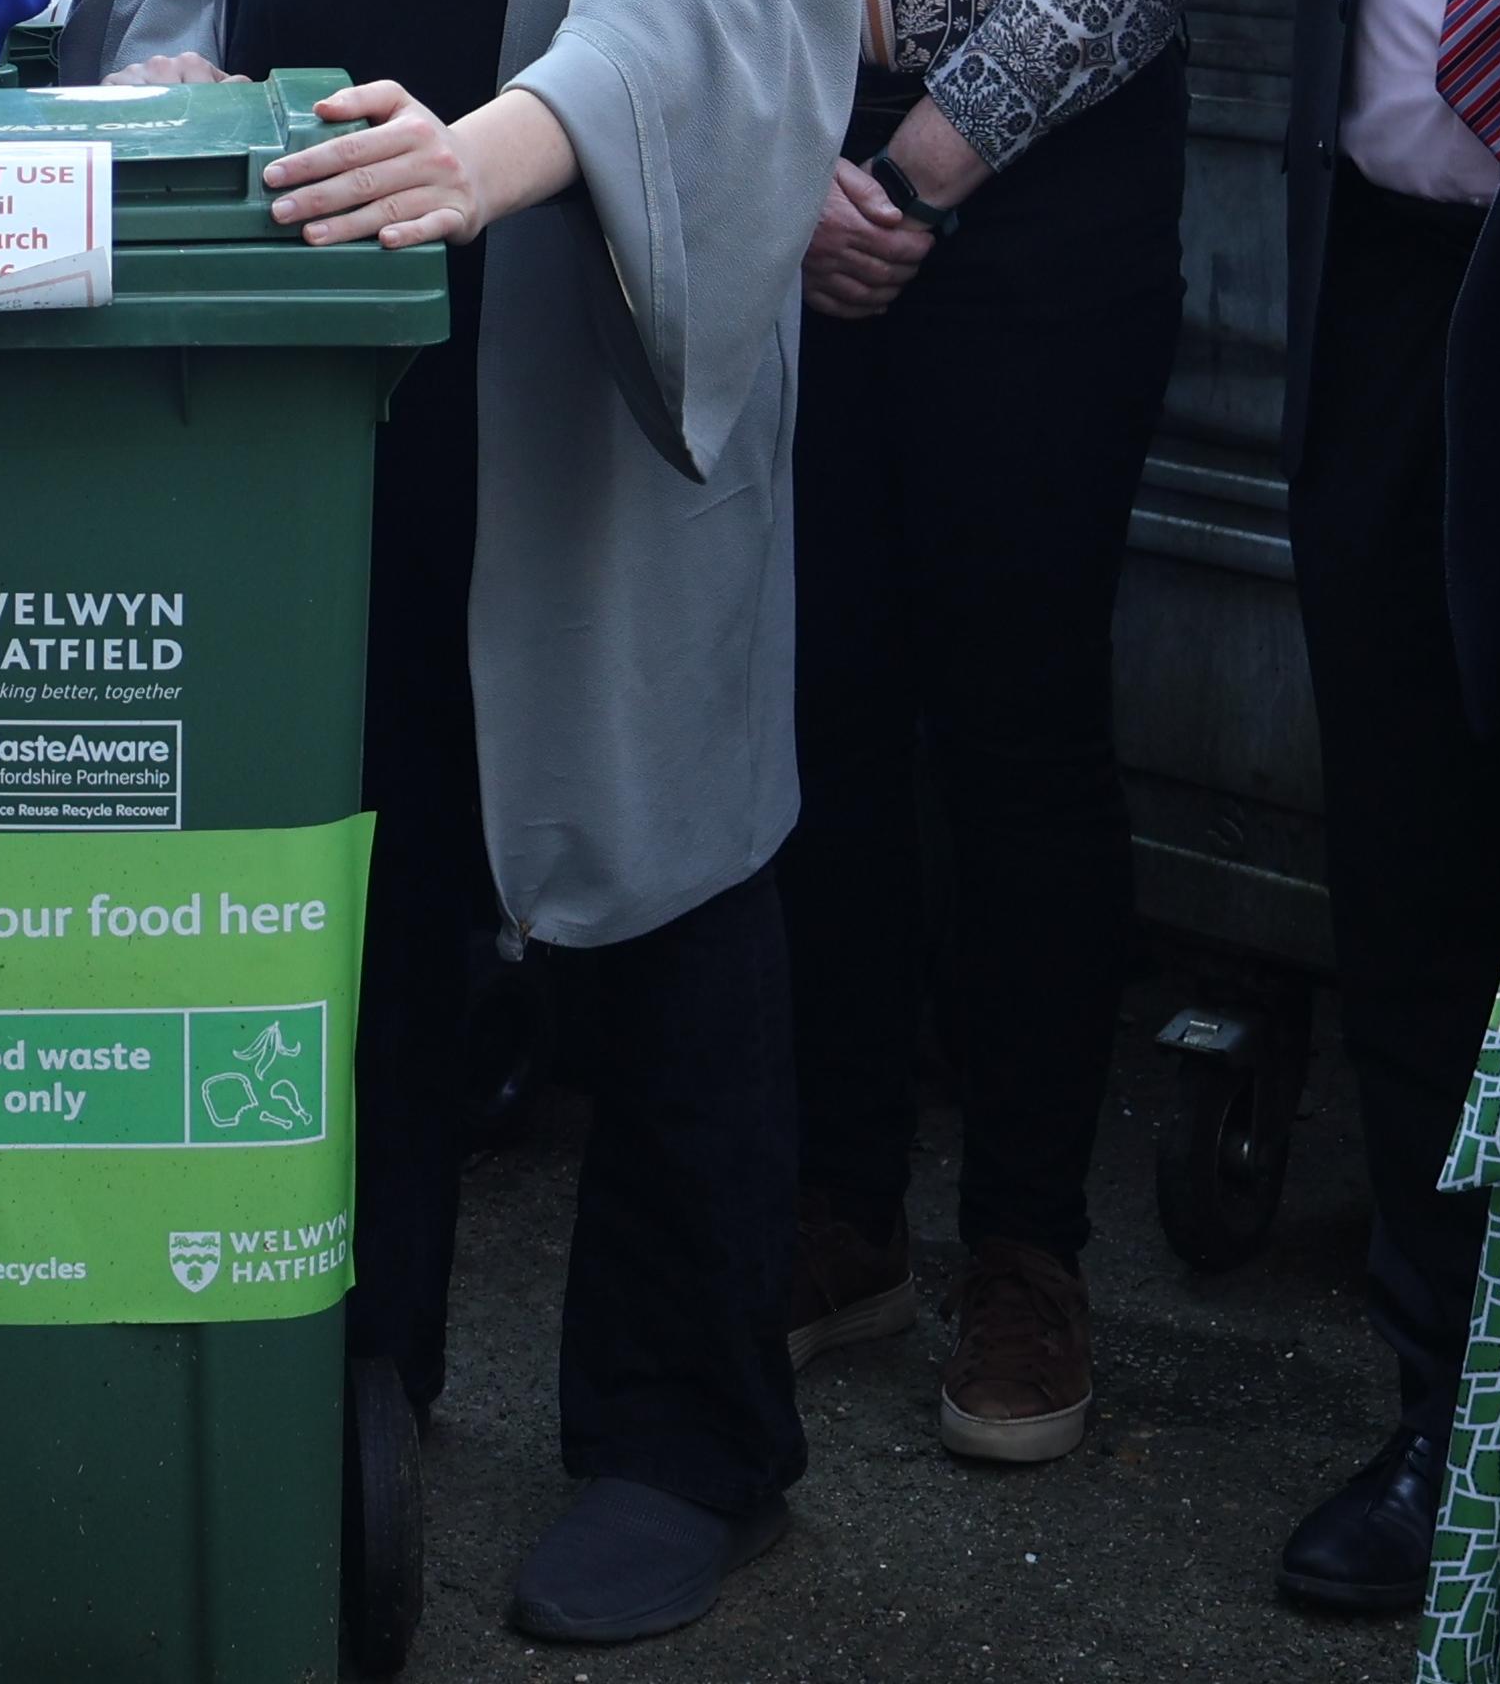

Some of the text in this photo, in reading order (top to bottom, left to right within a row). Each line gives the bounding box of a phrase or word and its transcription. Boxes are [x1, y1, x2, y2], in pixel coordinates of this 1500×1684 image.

[95, 117, 190, 132] ONLY
[16, 166, 75, 184] USE
[41, 683, 99, 702] better,
[104, 683, 183, 703] together
[77, 768, 171, 788] Partnership
[19, 803, 59, 817] Reuse
[62, 803, 112, 820] Recycle
[116, 804, 170, 818] Recover
[88, 893, 201, 938] food
[219, 892, 326, 935] here
[37, 1044, 151, 1071] waste
[4, 1082, 87, 1120] only
[229, 1208, 347, 1255] WELWYN
[231, 1239, 346, 1284] HATFIELD
